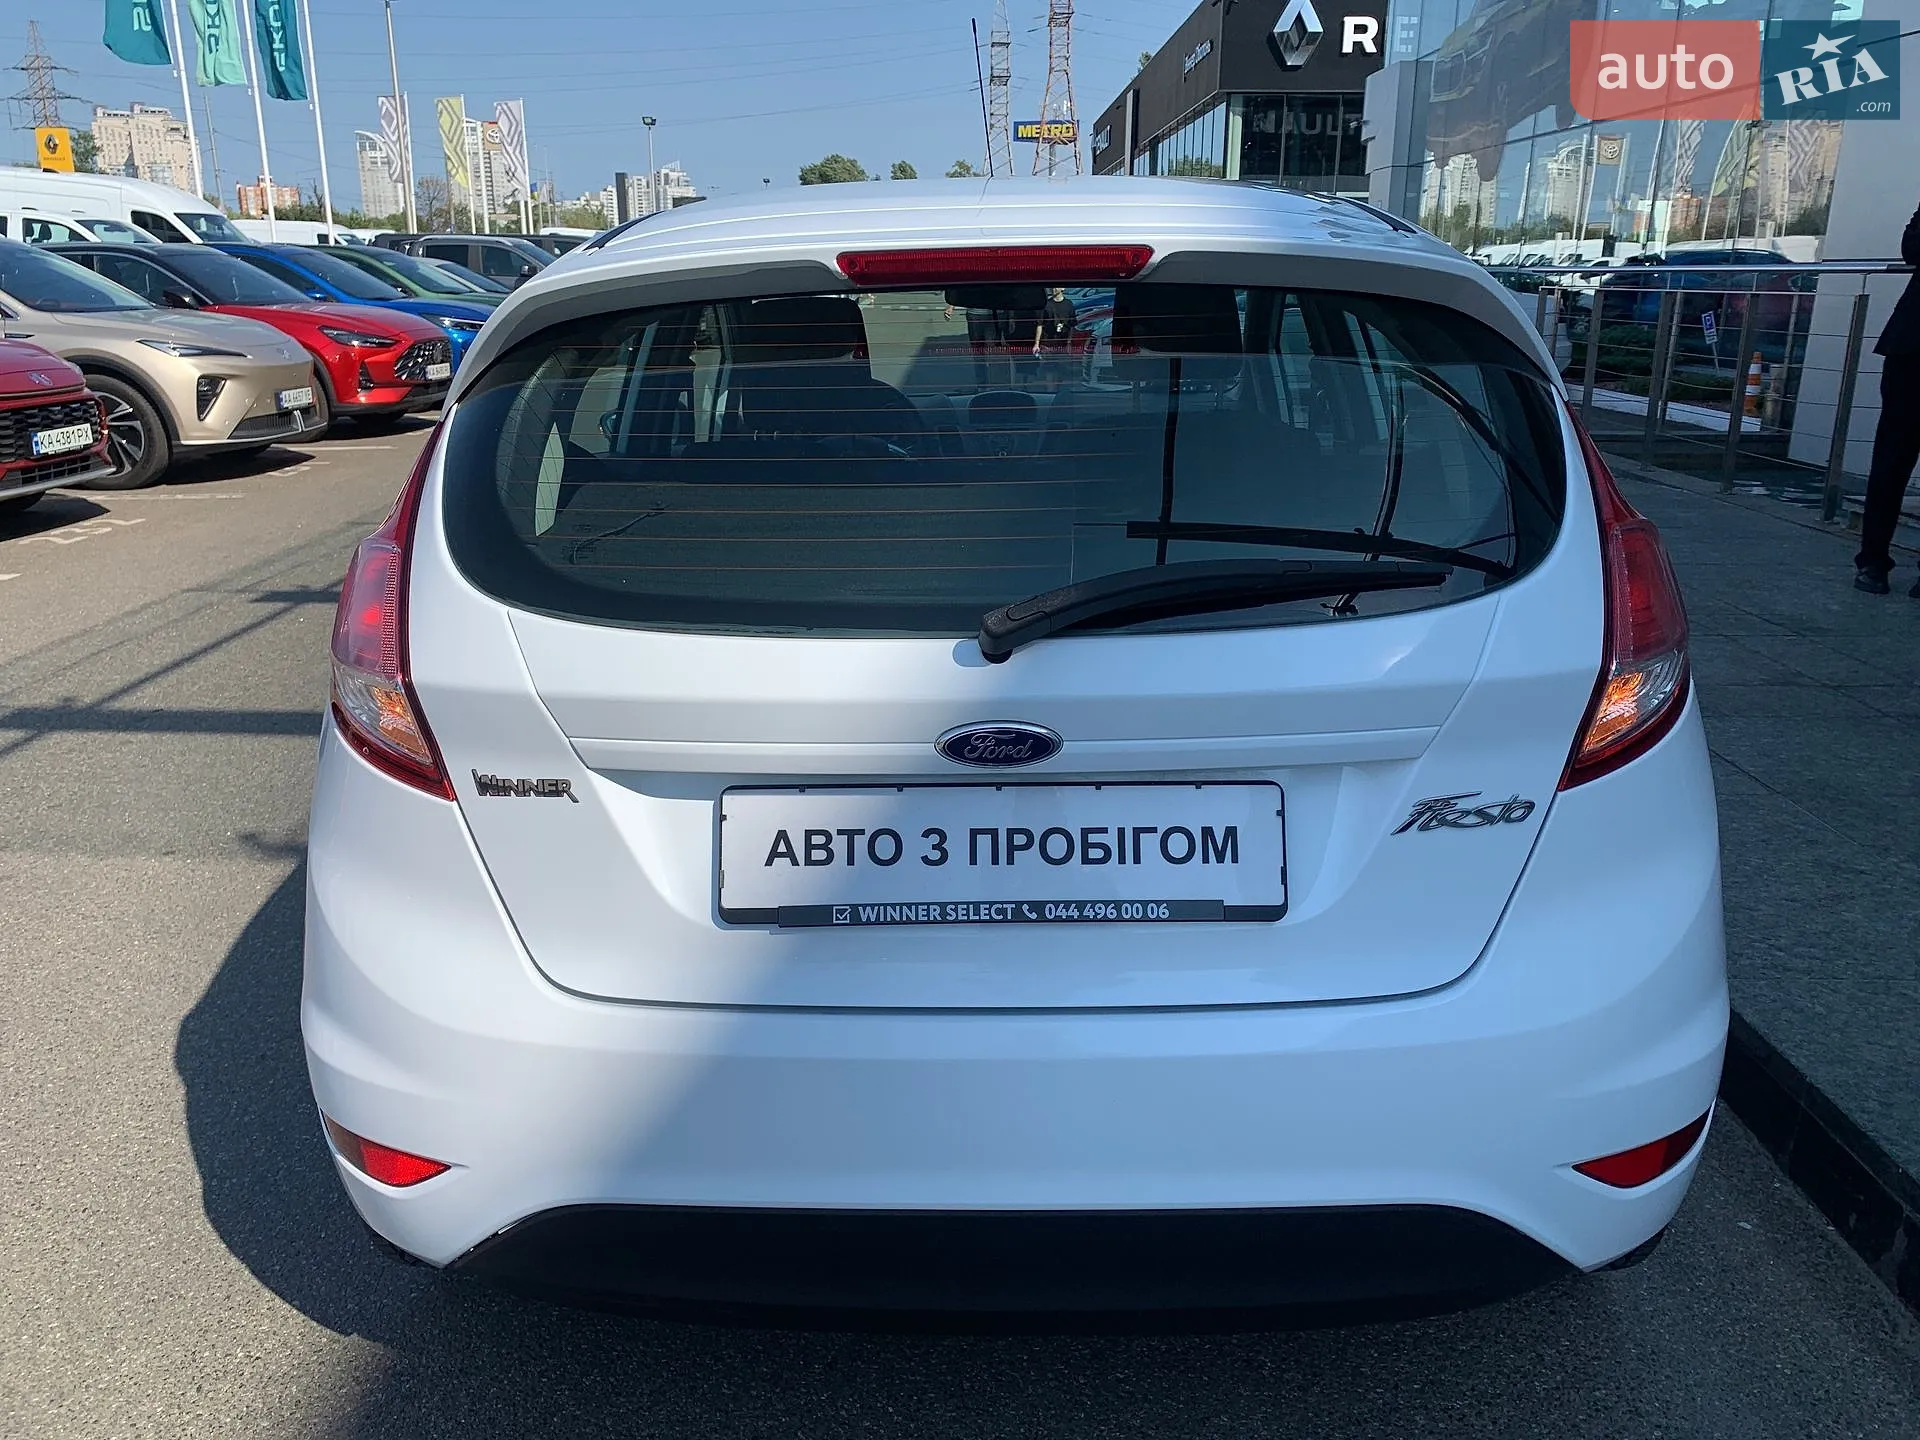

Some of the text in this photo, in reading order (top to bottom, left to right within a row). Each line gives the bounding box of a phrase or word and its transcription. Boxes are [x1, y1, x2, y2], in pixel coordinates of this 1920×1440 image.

[964, 733, 1034, 759] Ford
[471, 768, 580, 804] WINNER
[1390, 790, 1536, 836] Fiesta
[764, 825, 1240, 867] АВТО З ПРОБІГОМ
[858, 903, 1170, 922] WINNER SELECT 044 496 00 06
